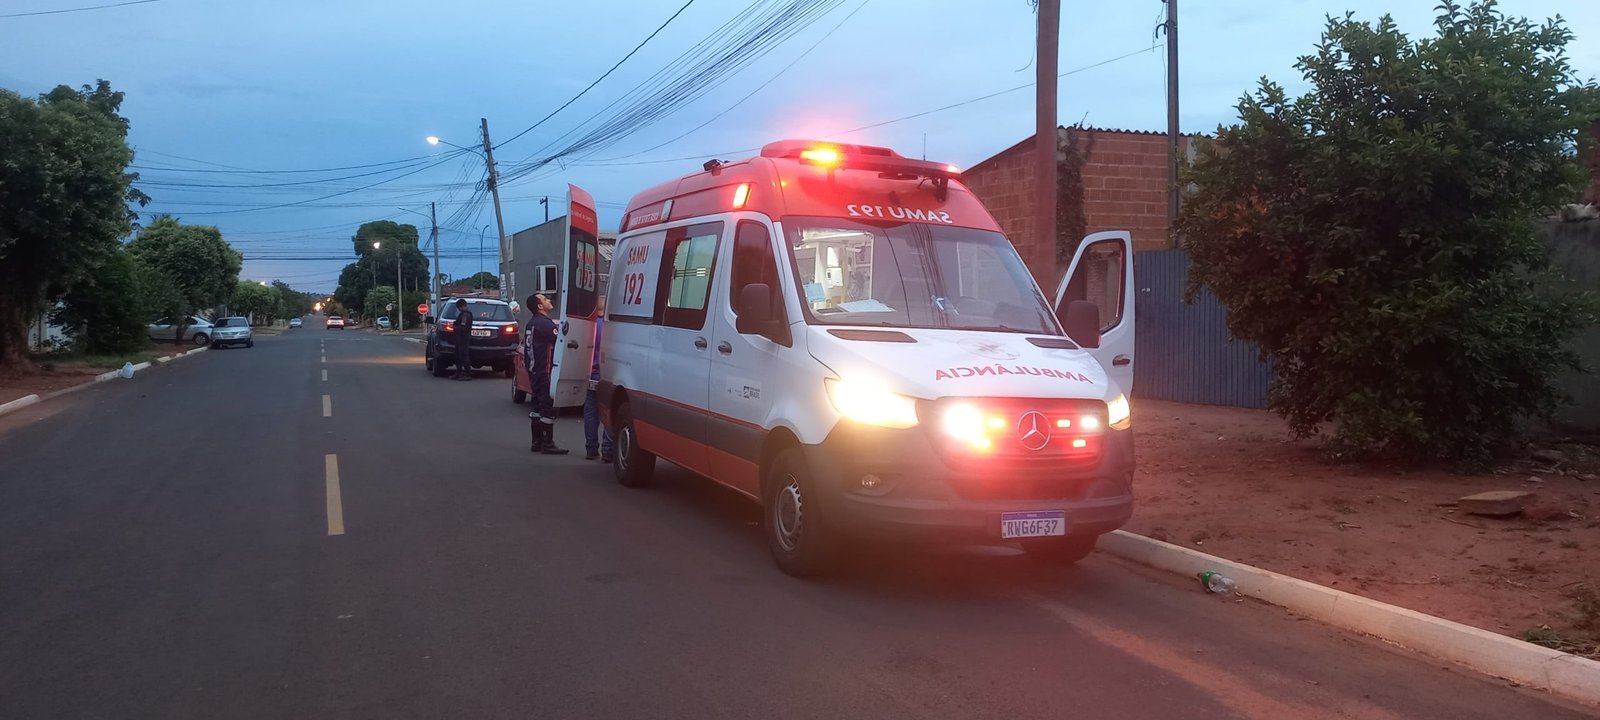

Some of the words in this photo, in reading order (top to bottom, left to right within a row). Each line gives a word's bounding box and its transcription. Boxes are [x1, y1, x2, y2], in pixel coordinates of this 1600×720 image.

[628, 245, 649, 265] SAMU
[623, 273, 645, 304] 192
[1007, 520, 1058, 536] RWG6F37
